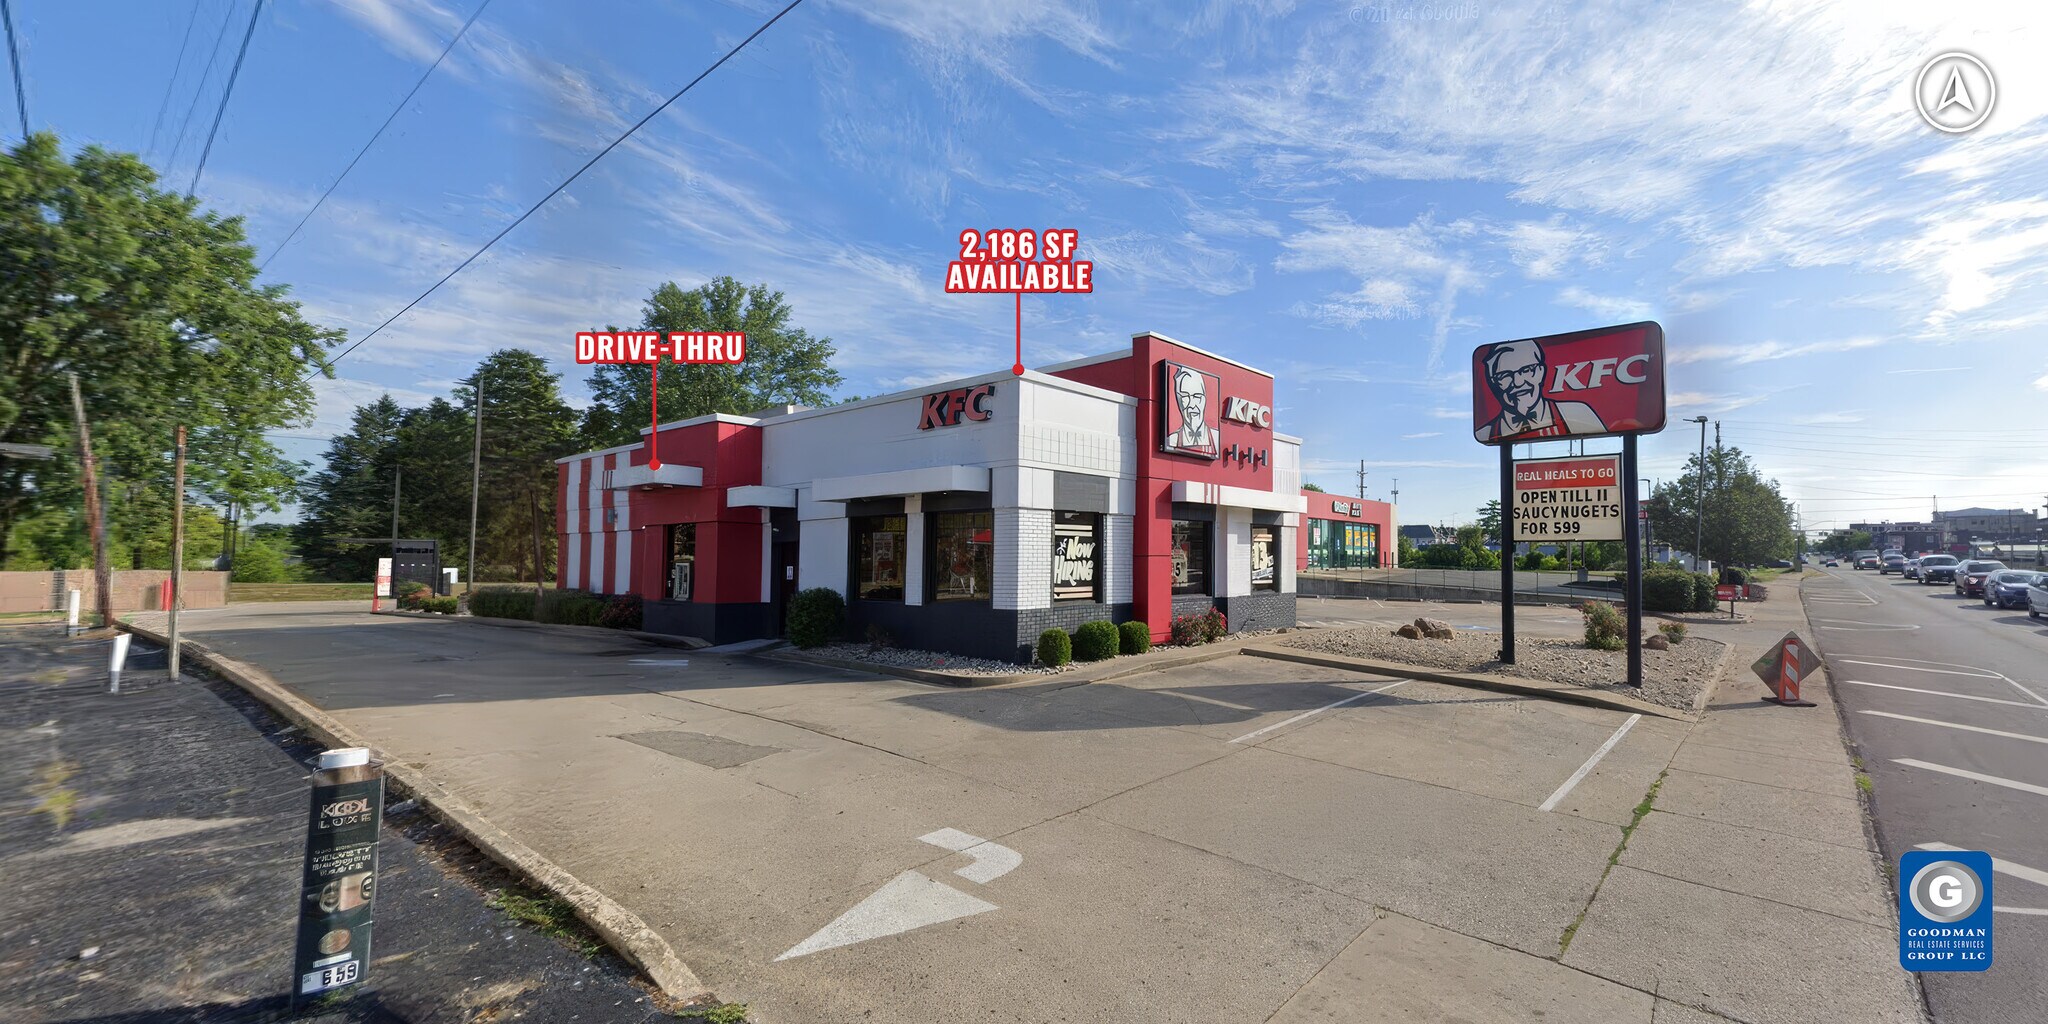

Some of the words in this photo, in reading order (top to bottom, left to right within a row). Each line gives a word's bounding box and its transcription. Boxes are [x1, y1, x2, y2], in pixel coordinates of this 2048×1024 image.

[1548, 354, 1650, 394] KFC
[917, 384, 995, 430] KFC
[1224, 396, 1271, 428] KFC
[1517, 471, 1542, 481] REAL
[1580, 468, 1595, 479] TO
[1598, 467, 1614, 478] GO
[1521, 490, 1557, 504] OPEN
[1561, 489, 1593, 502] TILL
[1521, 522, 1548, 535] FOR
[1554, 521, 1581, 534] 599
[1053, 555, 1094, 587] HIRING
